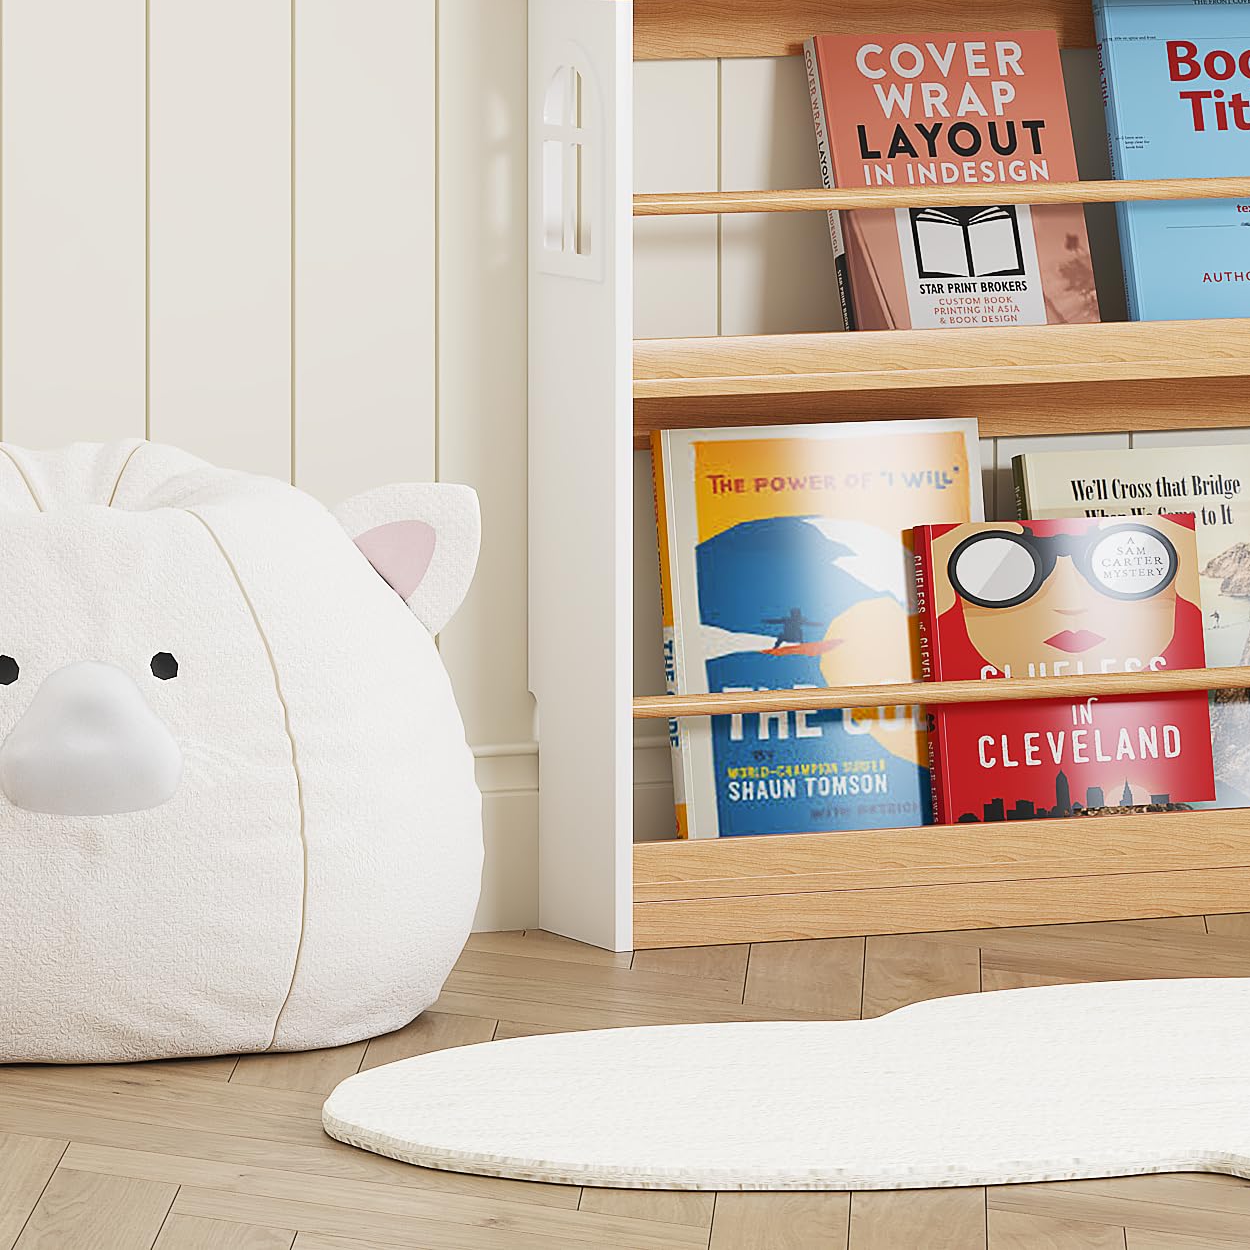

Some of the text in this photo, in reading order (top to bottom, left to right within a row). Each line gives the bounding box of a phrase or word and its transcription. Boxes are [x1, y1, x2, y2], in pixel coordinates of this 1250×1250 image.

[856, 41, 1024, 79] COVER
[806, 50, 817, 93] COVER
[812, 96, 823, 138] WRAP
[873, 81, 1016, 119] WRAP
[856, 120, 1045, 159] LAYOUT
[864, 160, 1050, 186] IN INDESIGN
[919, 280, 1028, 295] STAR PRINT BROKERS
[934, 305, 1021, 315] PRINTING IN ASIA
[938, 296, 1013, 306] CUSTOM BOOK
[949, 315, 979, 324] BOOK
[981, 314, 1018, 323] DESIGN
[754, 476, 834, 493] POWER
[1070, 474, 1241, 502] We'll Cross that Bridge
[1201, 505, 1216, 526] to
[1220, 504, 1233, 525] It
[1117, 547, 1146, 555] SAM
[1127, 537, 1135, 545] A
[1101, 556, 1163, 567] CARTER
[1103, 567, 1164, 579] MYSTERY
[1072, 697, 1099, 725] IN
[977, 725, 1182, 769] CLEVELAND
[728, 774, 888, 802] SHAUN TOMSON
